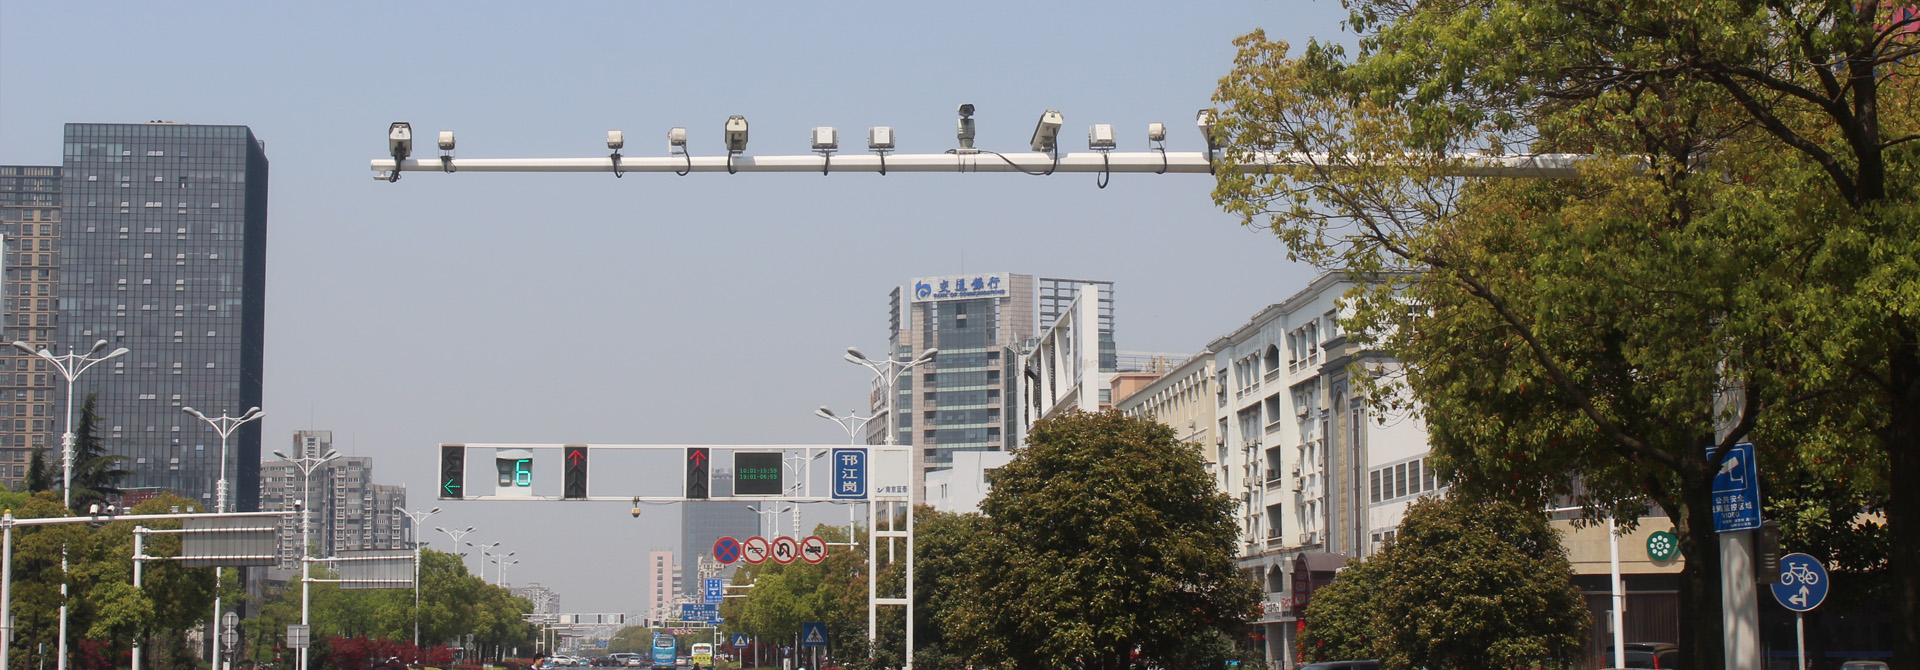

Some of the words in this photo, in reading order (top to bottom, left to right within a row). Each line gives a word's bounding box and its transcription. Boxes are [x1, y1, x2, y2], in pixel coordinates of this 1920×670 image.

[516, 459, 531, 486] 6
[842, 455, 858, 492] 邗江岗
[1715, 494, 1744, 504] 公共安全
